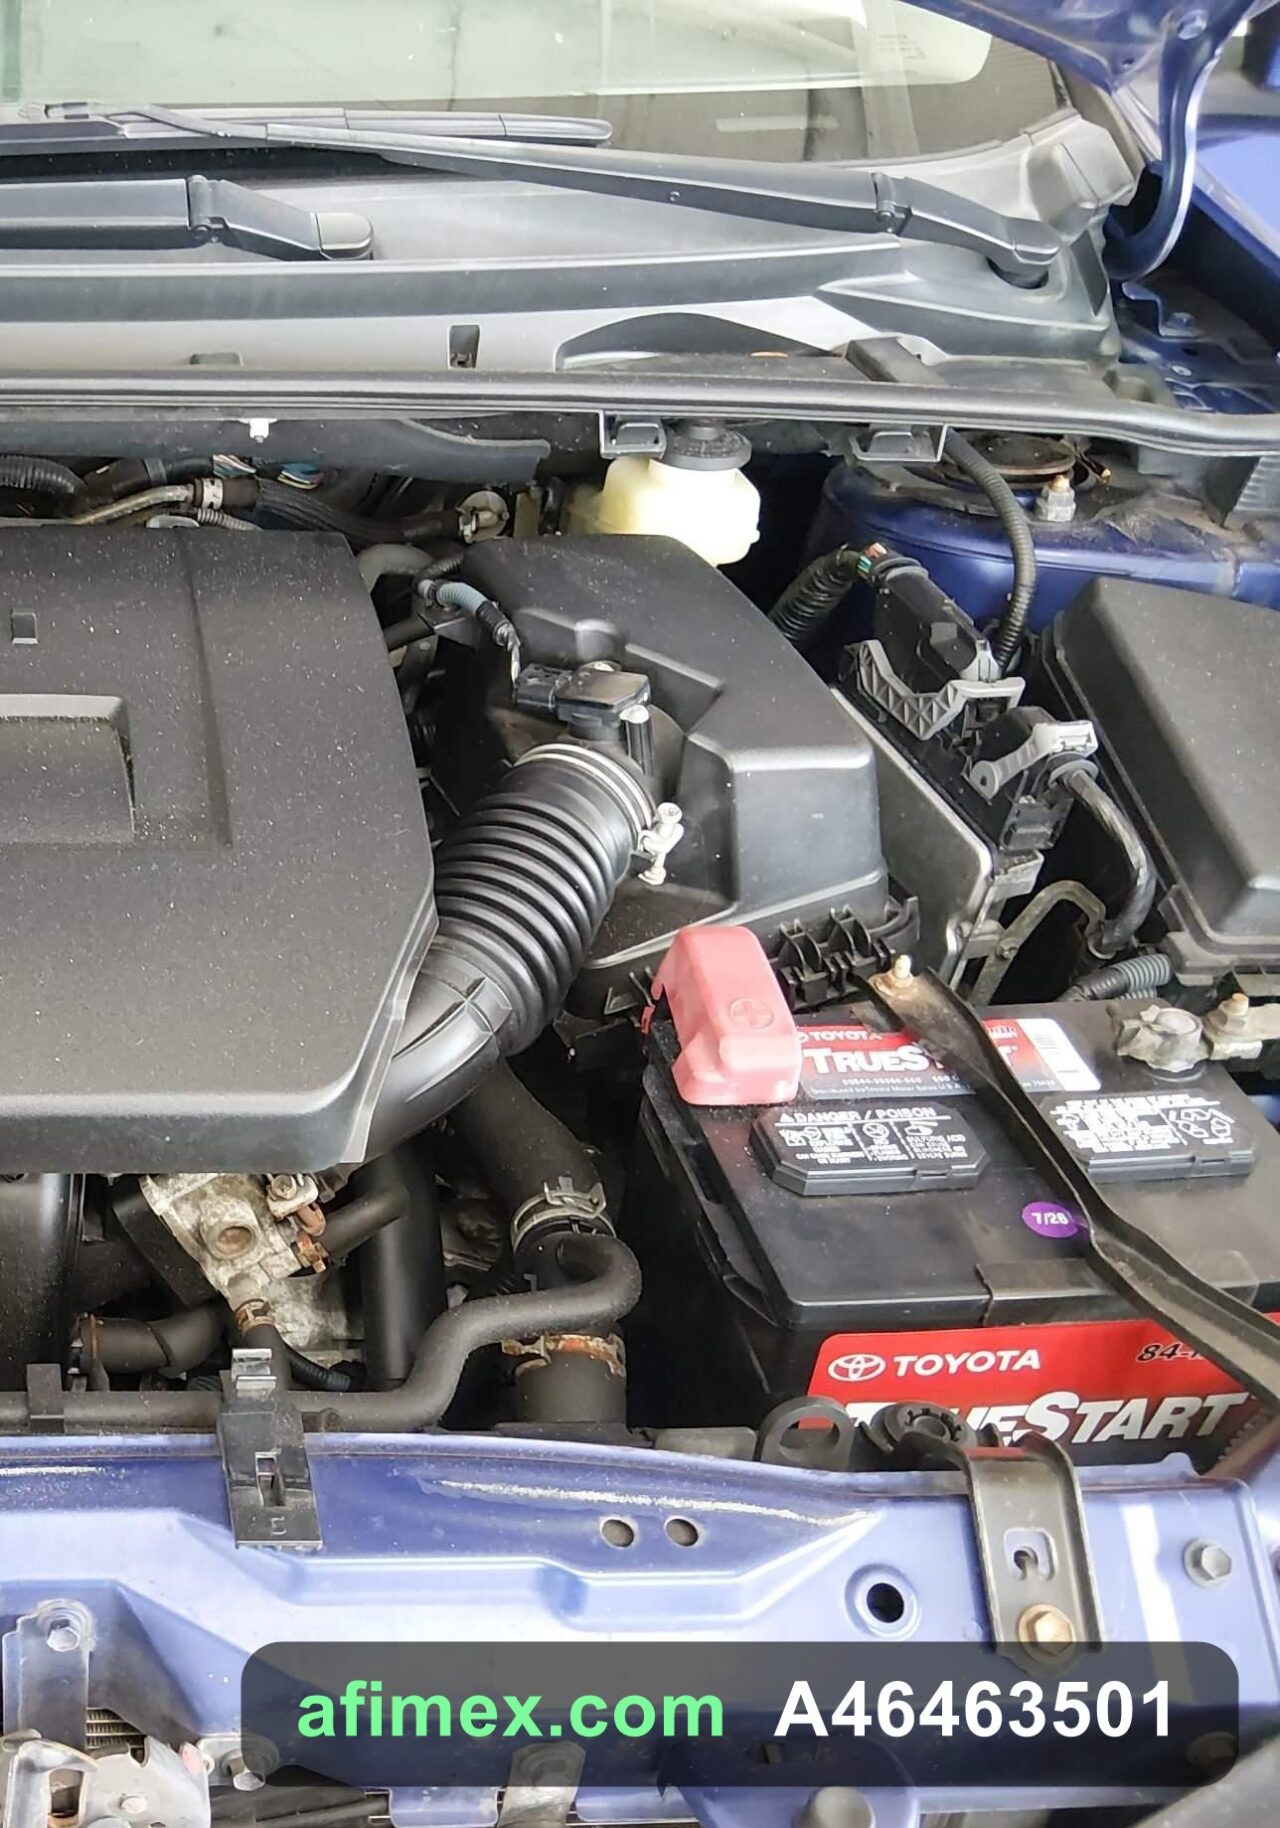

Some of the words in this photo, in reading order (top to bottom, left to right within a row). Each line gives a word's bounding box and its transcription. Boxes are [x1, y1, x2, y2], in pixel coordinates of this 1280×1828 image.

[793, 1111, 862, 1123] DANGER
[875, 1107, 937, 1119] POISON
[894, 1348, 1040, 1377] TOYOTA
